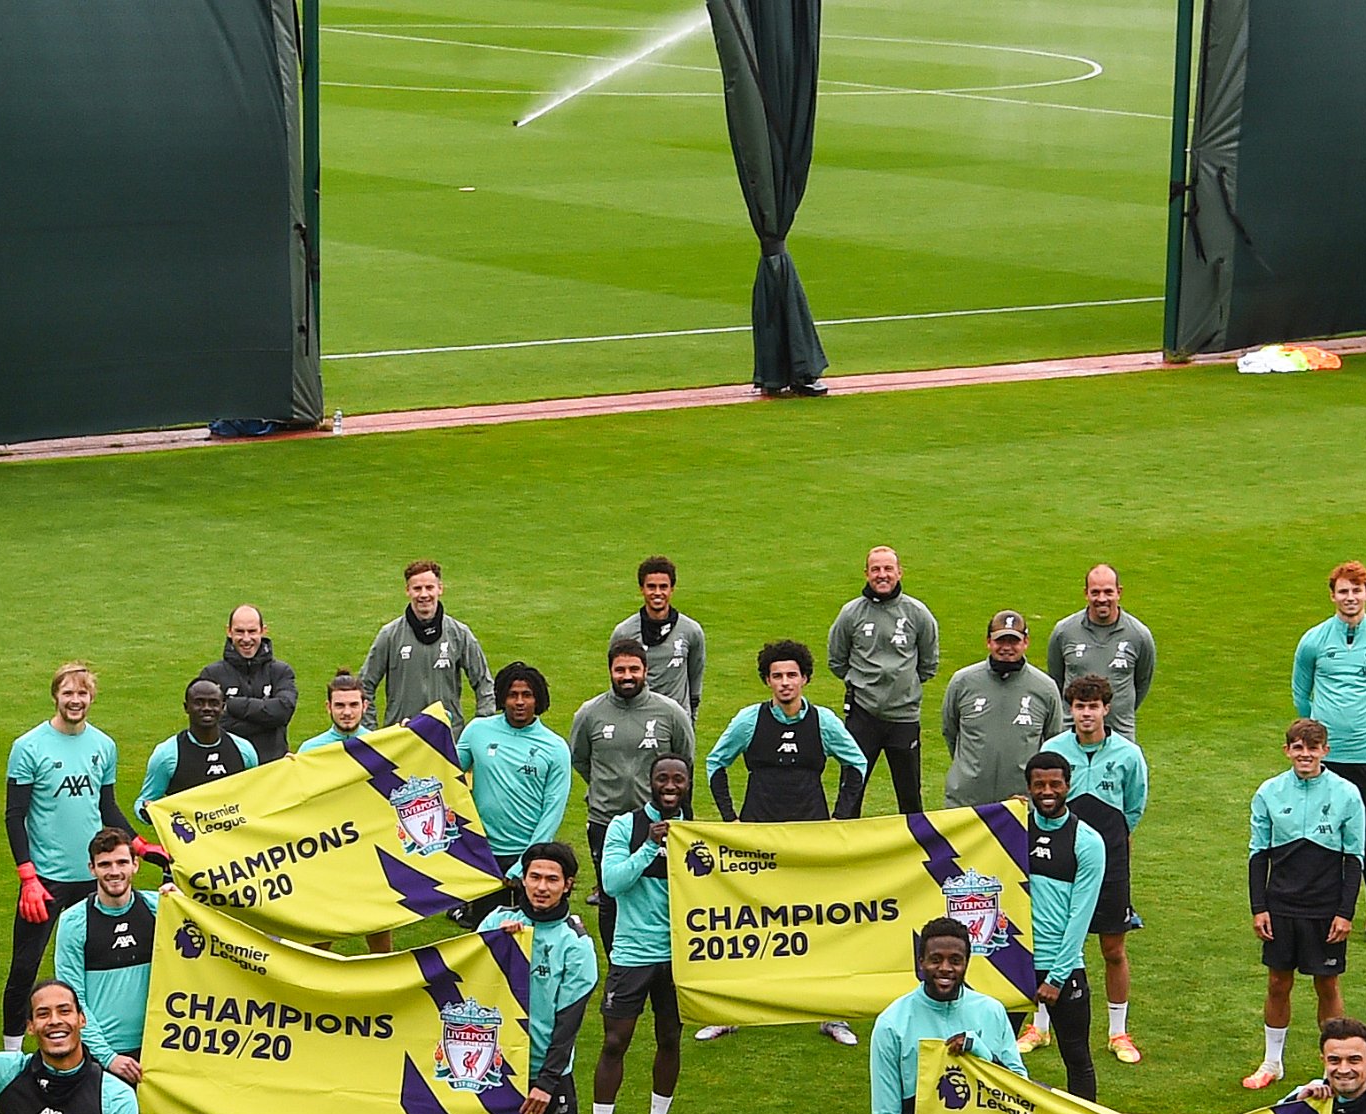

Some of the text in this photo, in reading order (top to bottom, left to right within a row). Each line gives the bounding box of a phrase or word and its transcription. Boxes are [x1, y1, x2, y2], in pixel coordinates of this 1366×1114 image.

[1012, 714, 1033, 725] AXA
[637, 738, 659, 749] AXA
[777, 742, 798, 753] AXA
[206, 764, 227, 775] AXA
[53, 775, 94, 797] AXA
[195, 805, 239, 825] Premier
[400, 799, 442, 818] LIVERPOOL
[193, 817, 246, 835] League
[189, 822, 360, 890] CHAMPIONS
[719, 845, 776, 860] Premier
[1029, 846, 1052, 860] AXA
[720, 860, 777, 875] League
[687, 898, 899, 932] CHAMPIONS
[950, 901, 995, 911] LIVERPOOL
[111, 934, 137, 949] AXA
[211, 934, 269, 962] Premier
[688, 932, 808, 961] 2019/20
[210, 948, 267, 976] League
[166, 992, 393, 1039] CHAMPIONS
[161, 1023, 291, 1061] 2019/20
[447, 1030, 493, 1041] LIVERPOOL
[977, 1079, 1037, 1112] Premier
